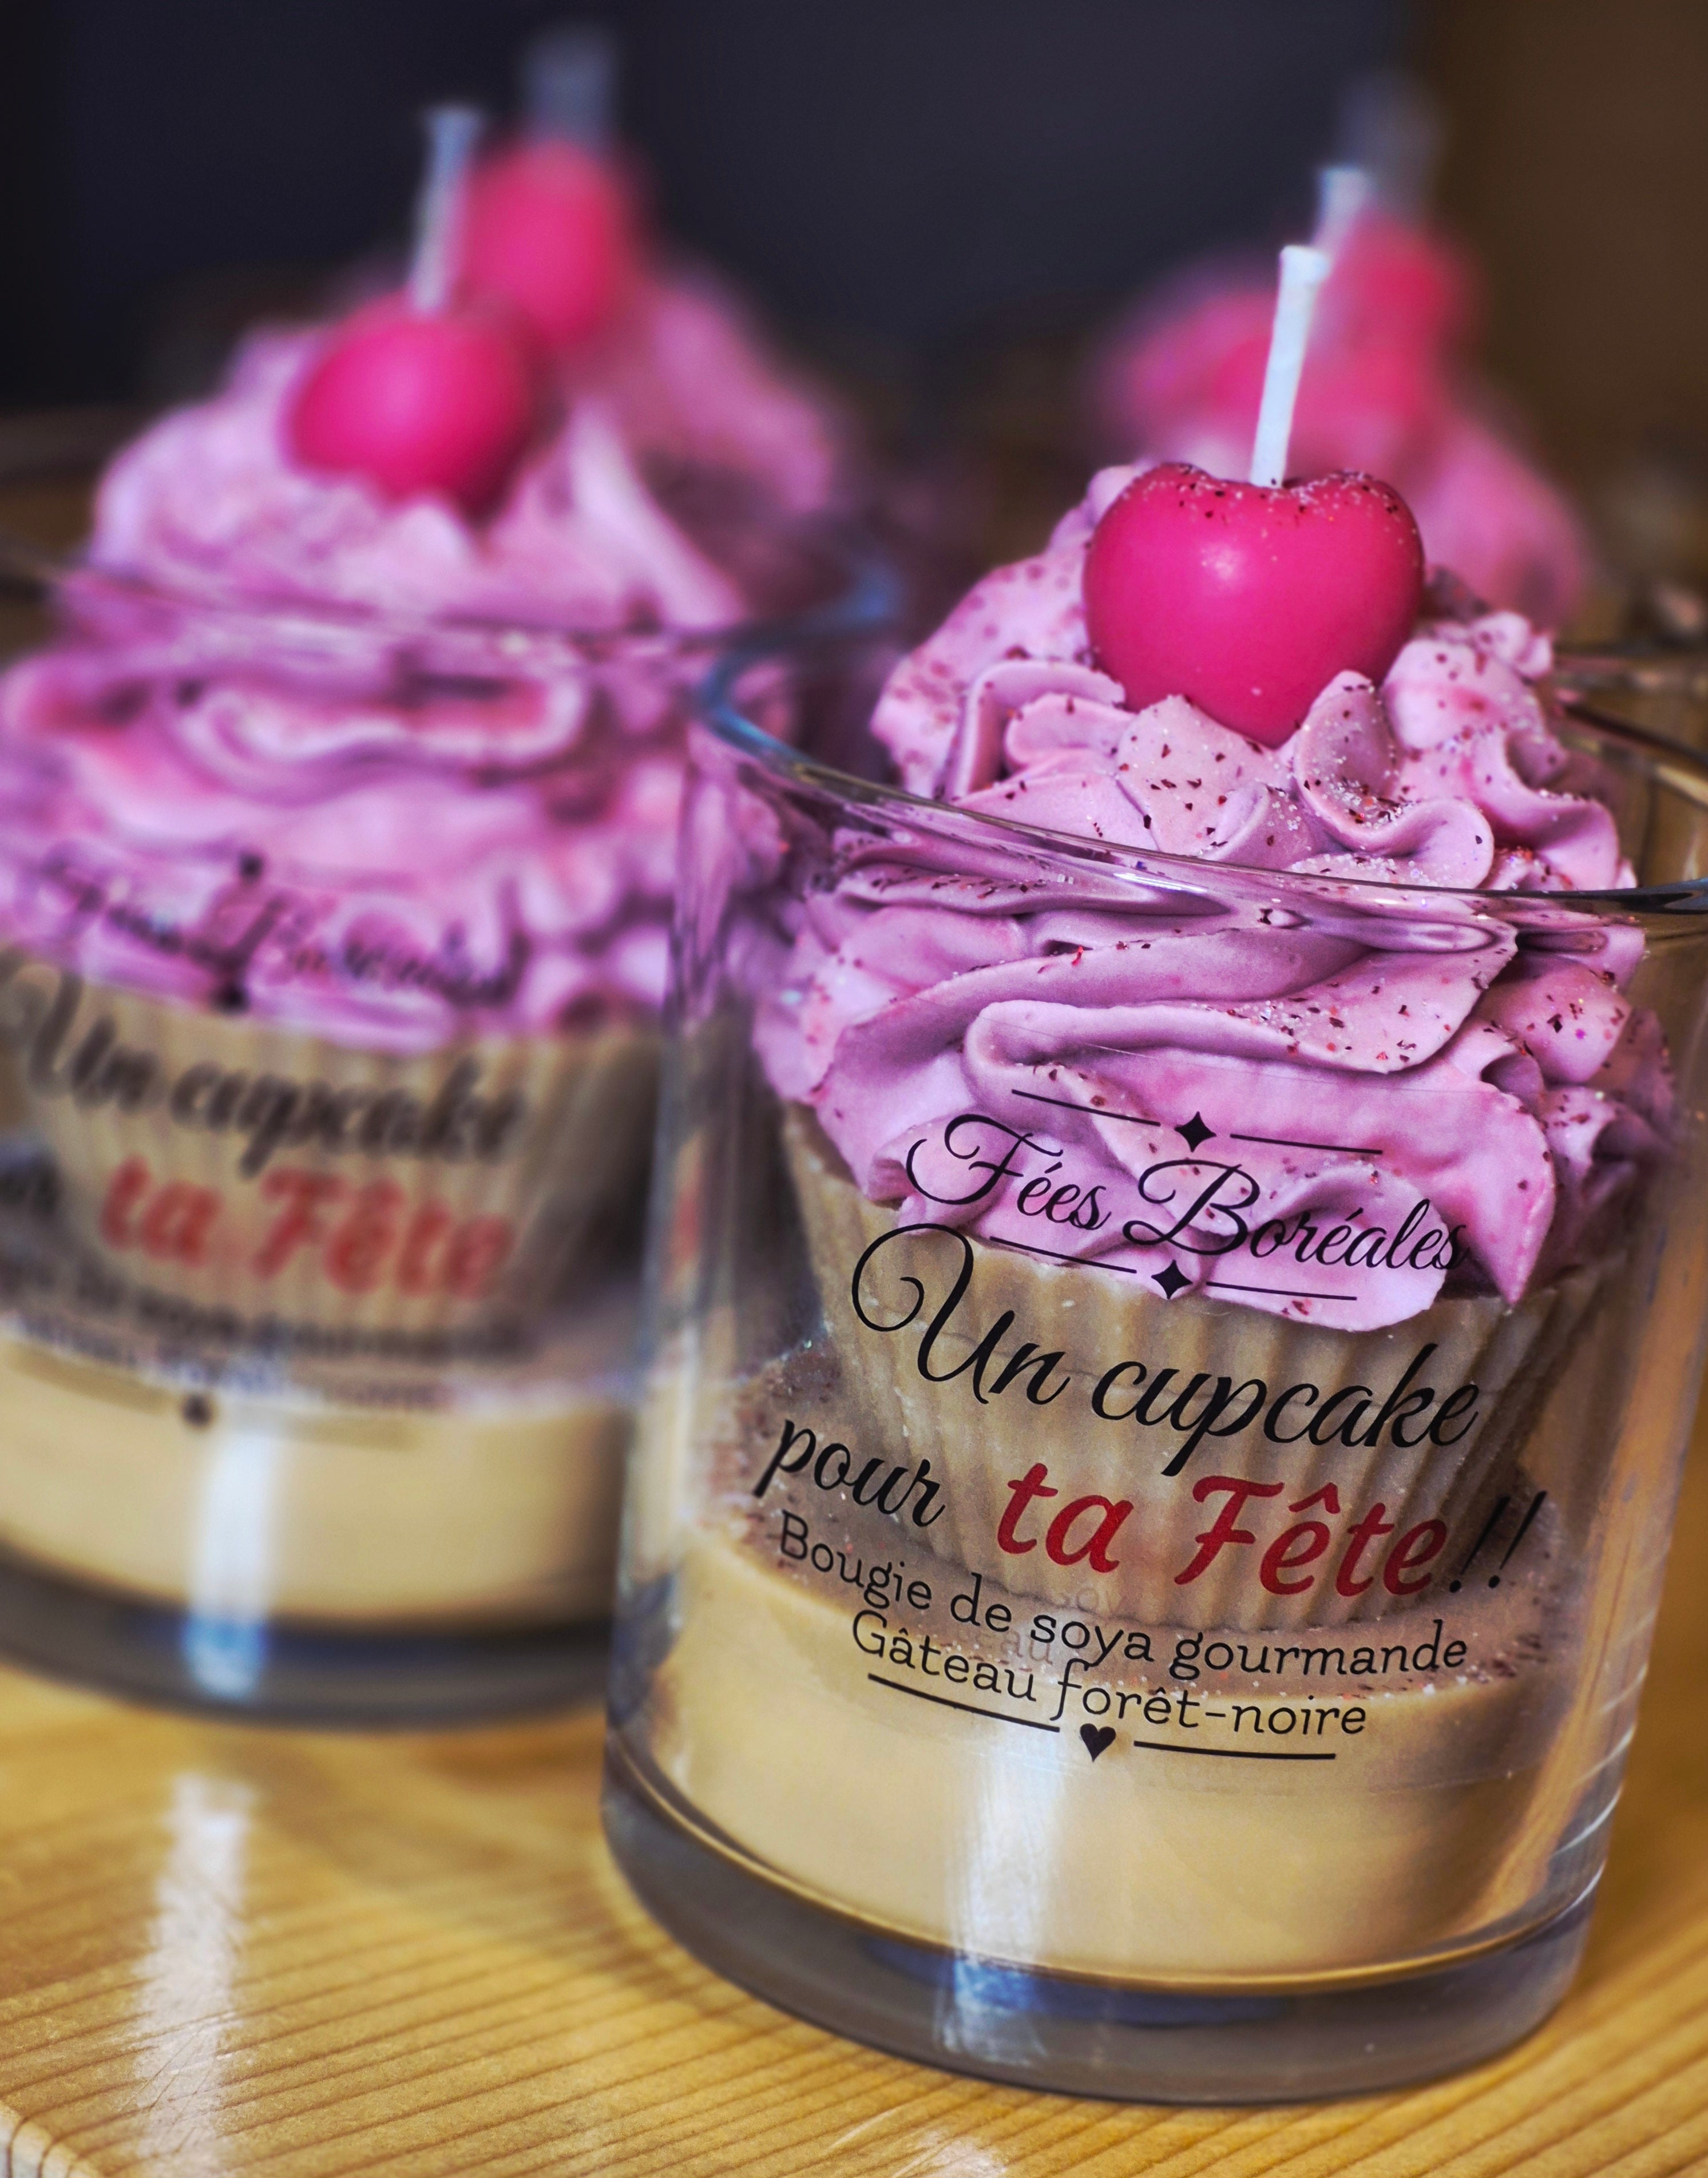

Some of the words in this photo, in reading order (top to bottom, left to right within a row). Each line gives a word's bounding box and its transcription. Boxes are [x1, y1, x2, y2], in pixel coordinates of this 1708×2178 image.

[906, 1113, 1111, 1231] Fées
[1122, 1159, 1470, 1271] Boréales
[852, 1223, 1071, 1405] Un
[1091, 1343, 1480, 1476] cupcake
[753, 1419, 946, 1527] pour
[997, 1463, 1135, 1574] ta
[780, 1509, 932, 1609] Bougie
[950, 1572, 1012, 1632] de
[1031, 1614, 1155, 1667] soya
[1169, 1619, 1469, 1681] gourmande
[852, 1610, 1037, 1702] Gâteau
[1053, 1657, 1368, 1736] forêt-noire
